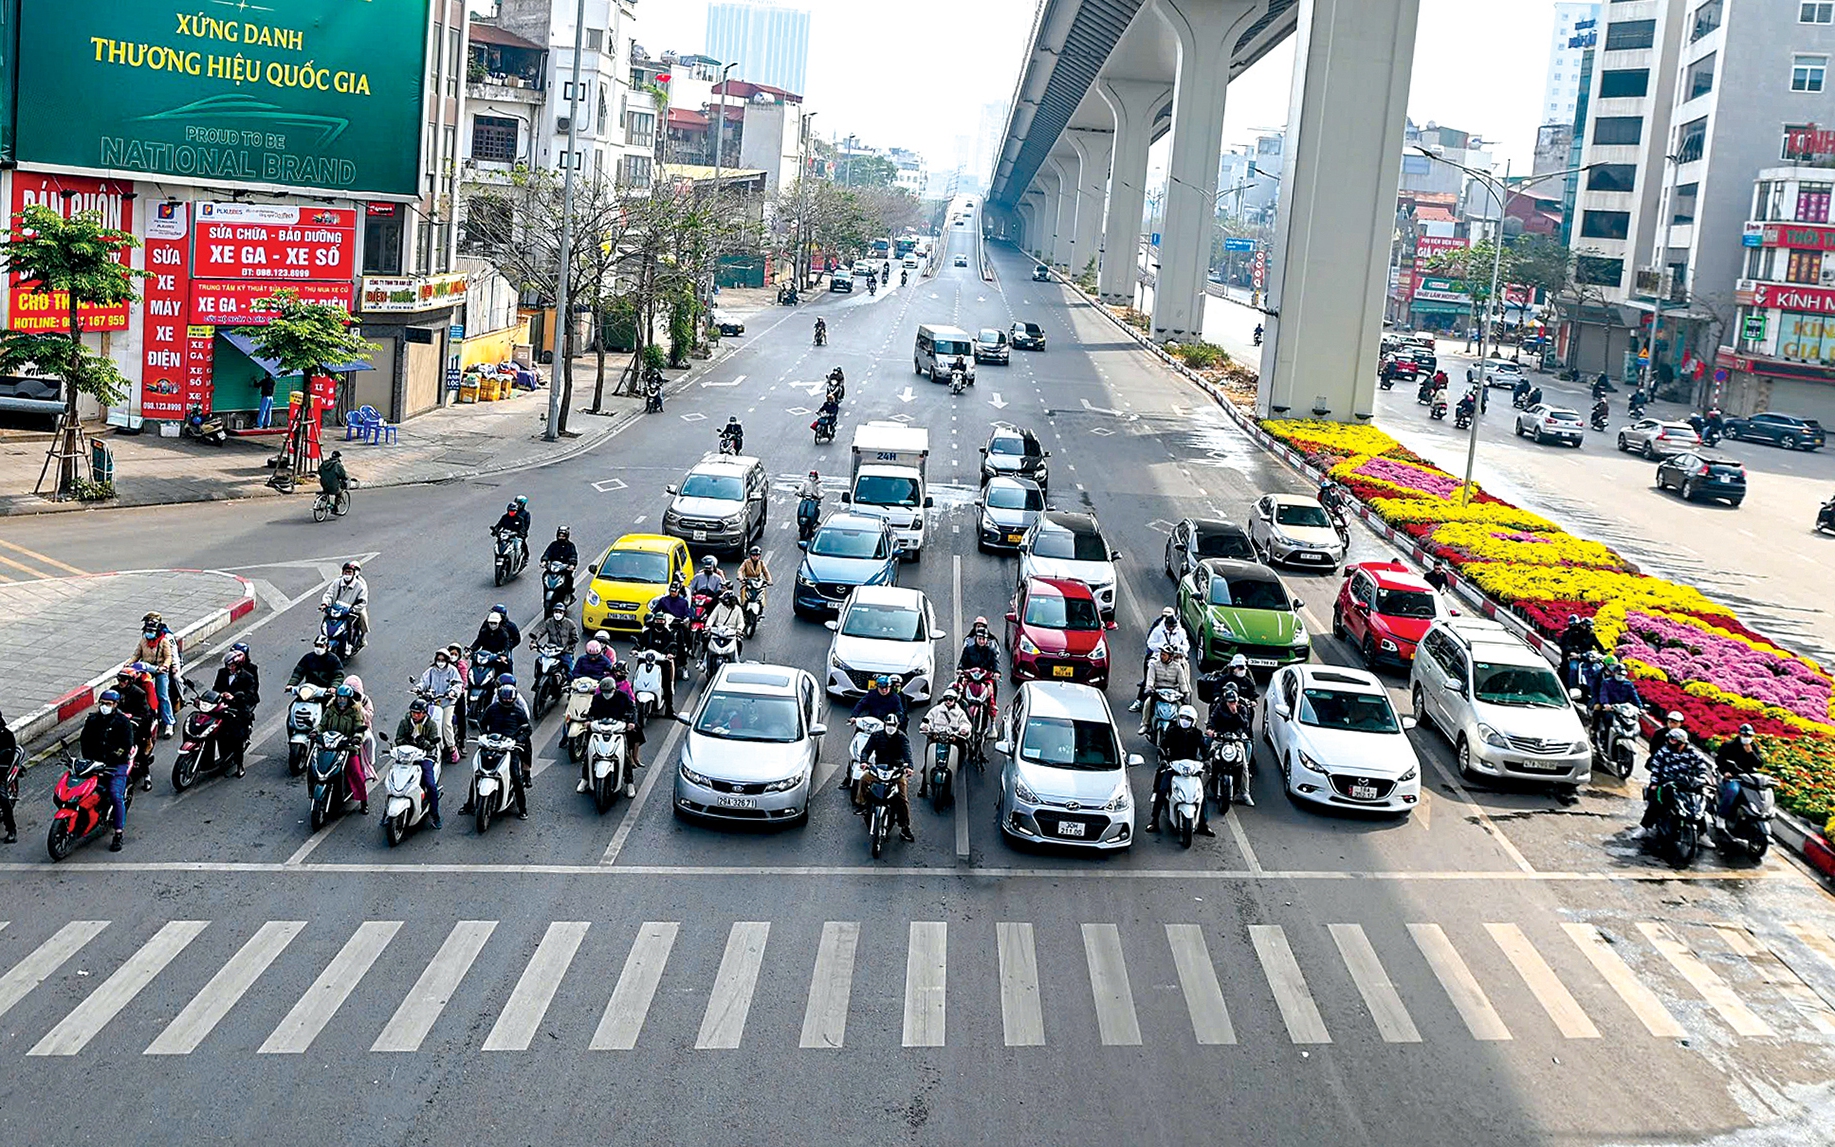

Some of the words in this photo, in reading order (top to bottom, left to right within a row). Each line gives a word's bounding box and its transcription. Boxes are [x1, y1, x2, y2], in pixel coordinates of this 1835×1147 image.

[176, 13, 238, 42] XỨNG
[244, 23, 303, 51] DANH
[91, 36, 201, 75] THƯƠNG
[207, 52, 261, 86] HIỆU
[266, 60, 330, 90] QUỐC
[334, 71, 370, 95] GIA
[186, 126, 239, 145] PROUD
[242, 131, 261, 147] TO
[266, 133, 285, 150] BE
[101, 136, 256, 177] NATIONAL
[263, 152, 356, 185] BRAND
[209, 224, 232, 239] SỬA
[237, 227, 267, 241] CHỮA
[279, 227, 301, 242] BẢO
[305, 230, 342, 244] DƯỠNG
[152, 244, 181, 265] SỬA
[210, 245, 234, 263] XE
[241, 246, 267, 264] GA
[286, 247, 309, 265] XE
[315, 244, 340, 266] SỐ
[157, 274, 175, 291] XE
[222, 283, 235, 291] TÂM
[19, 293, 49, 310] CHO
[150, 298, 181, 316] MÁY
[198, 297, 215, 312] XE
[219, 298, 237, 312] GA
[1777, 290, 1820, 309] KÍNH
[14, 317, 59, 329] HOTLINE:
[89, 316, 105, 326] 167
[108, 315, 125, 326] 959
[156, 325, 174, 341] XE
[191, 341, 204, 349] XE
[148, 348, 180, 370] ĐIỆN
[190, 352, 203, 360] GA
[189, 367, 203, 375] XE
[189, 376, 202, 386] SỐ
[188, 392, 202, 400] XE
[876, 452, 897, 461] 24H
